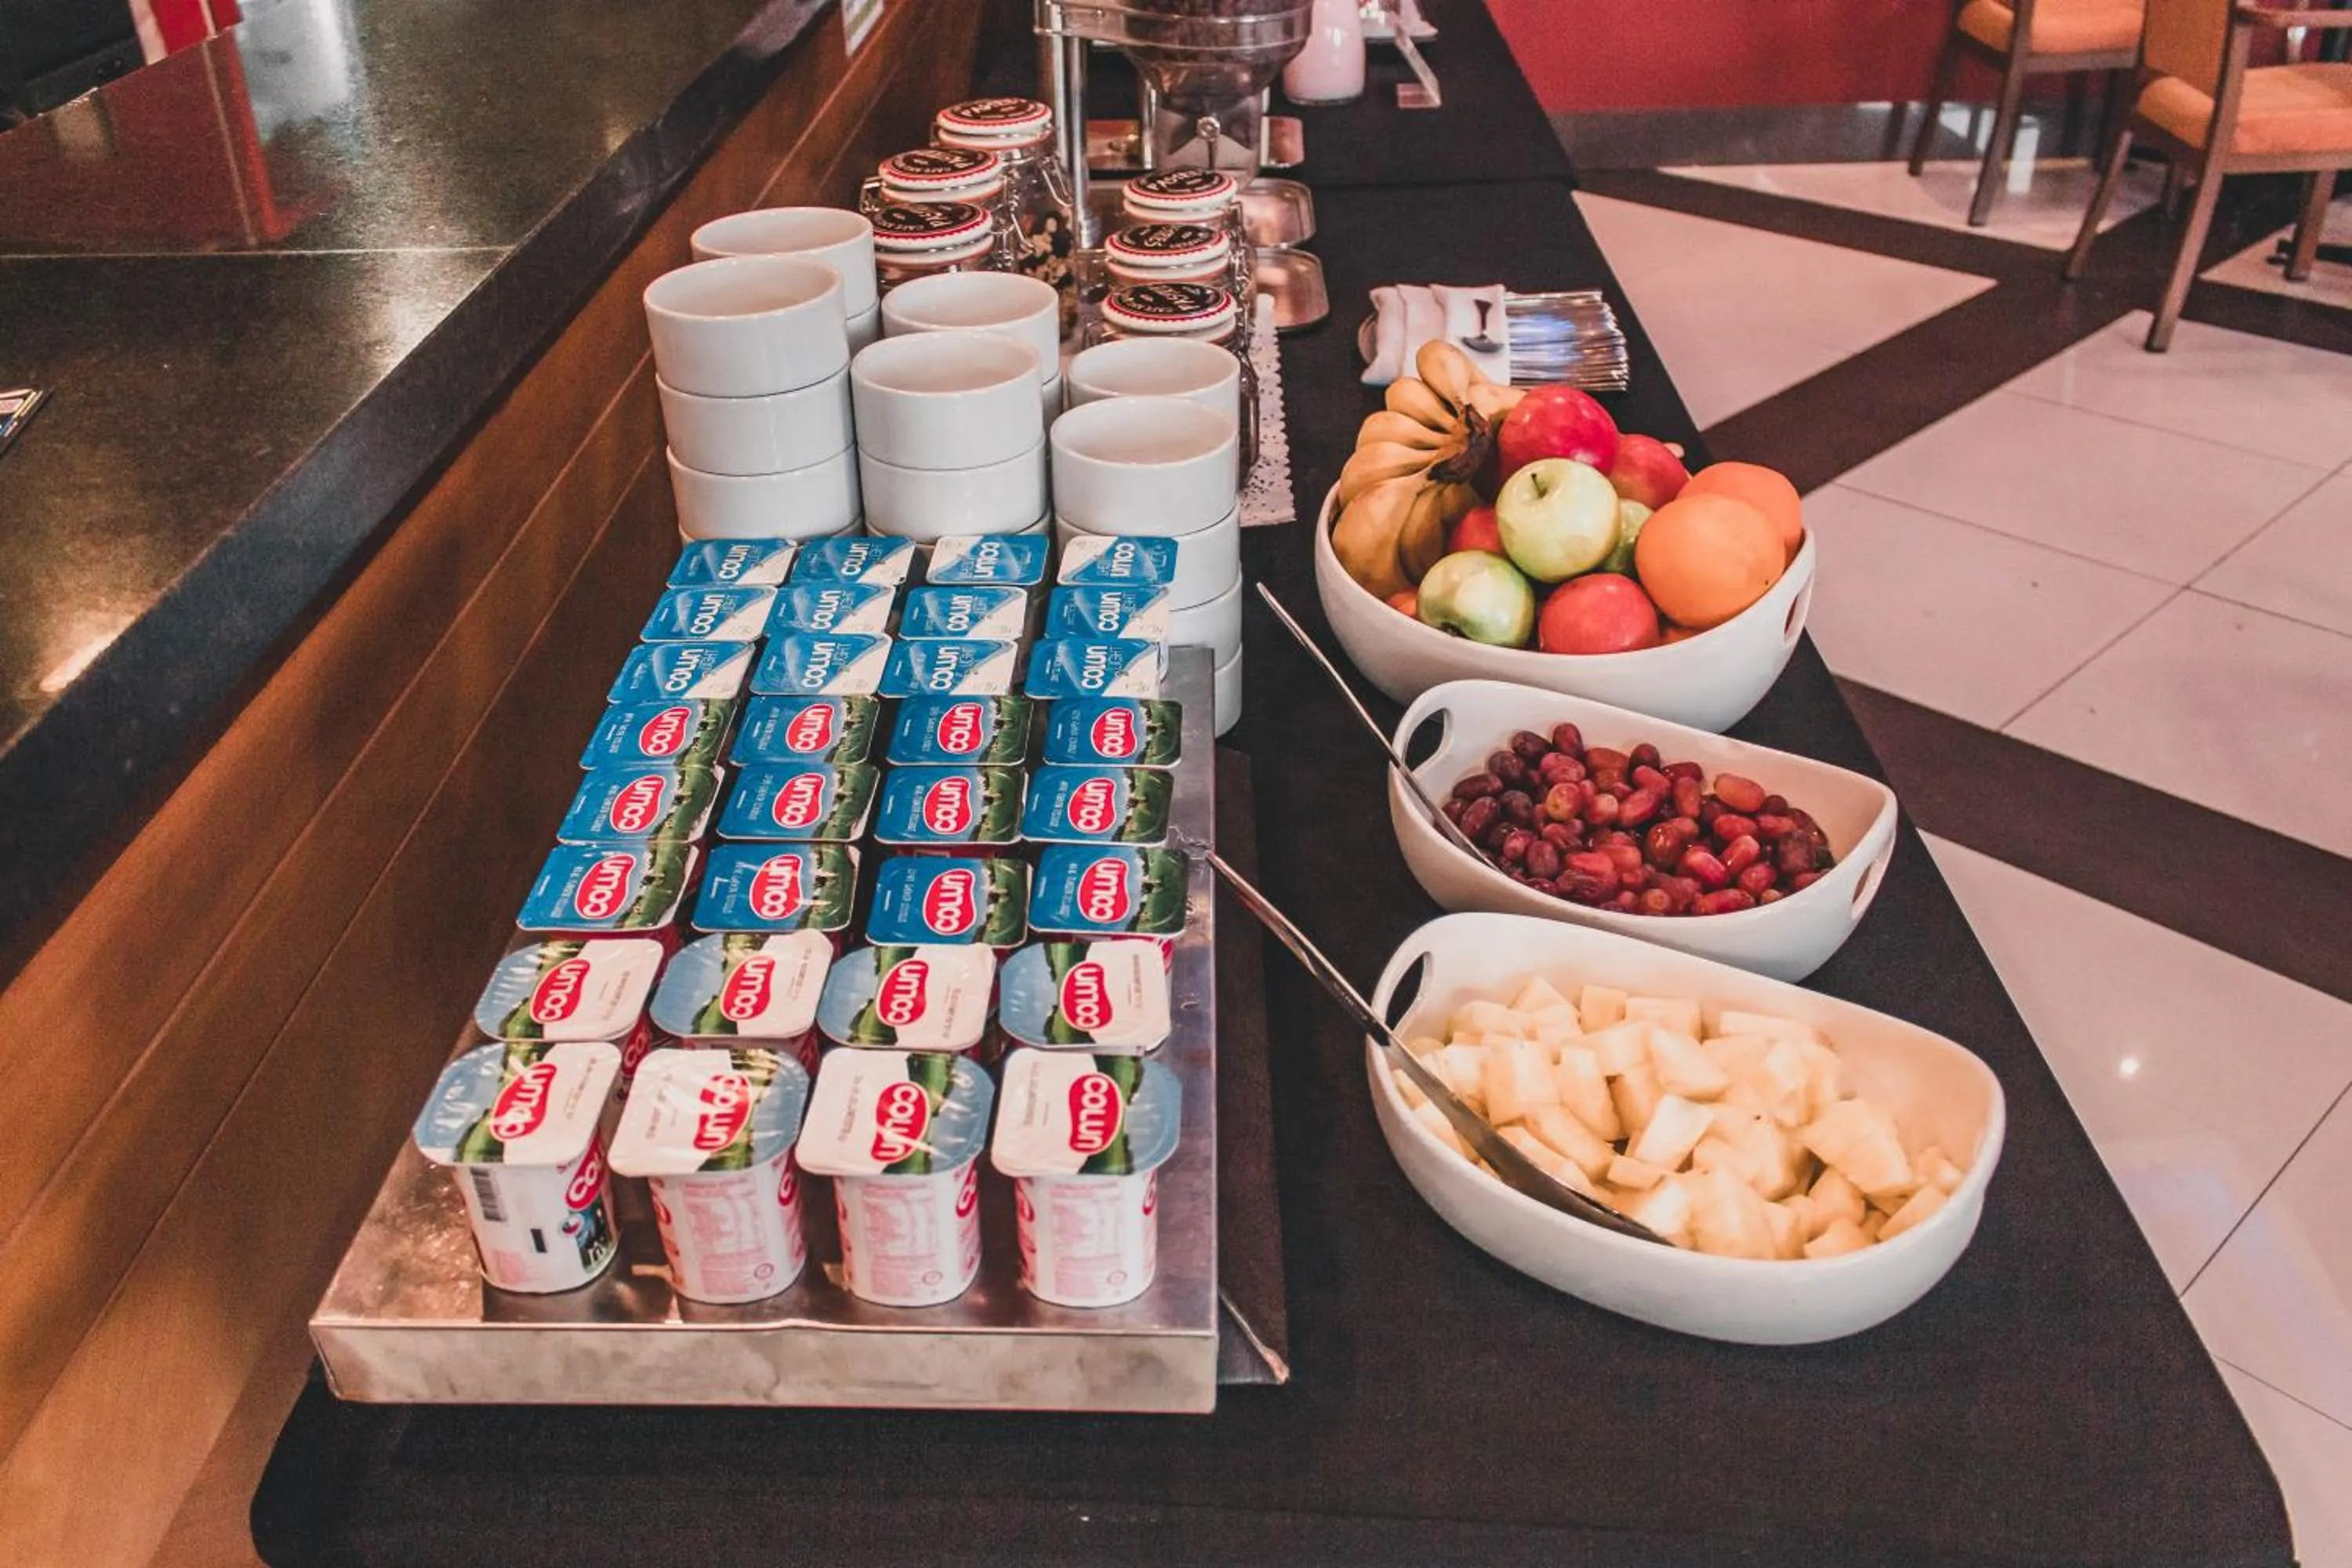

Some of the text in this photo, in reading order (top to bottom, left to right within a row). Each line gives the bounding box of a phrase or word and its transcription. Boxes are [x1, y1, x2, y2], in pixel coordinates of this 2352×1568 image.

[718, 544, 750, 579] COLUN
[840, 543, 869, 575] COLUN
[973, 542, 1000, 577] COLUN
[1110, 543, 1134, 577] COLUN
[690, 594, 726, 633] COLUN
[812, 590, 840, 629] COLUN
[947, 595, 974, 631] COLUN
[1098, 592, 1121, 630] COLUN
[664, 648, 704, 692] COLUN
[802, 642, 836, 688] COLUN
[929, 646, 958, 690] COLUN
[1081, 645, 1108, 689] COLUN
[648, 709, 684, 756] COLUN
[796, 706, 829, 751] COLUN
[950, 706, 978, 750] COLUN
[1103, 710, 1129, 756] COLUN
[619, 779, 659, 831] COLUN
[782, 775, 820, 826] COLUN
[931, 781, 967, 833] COLUN
[1082, 781, 1112, 831] COLUN
[582, 857, 628, 918] COLUN
[761, 858, 797, 918] COLUN
[934, 874, 971, 931] COLUN
[1092, 863, 1123, 921] COLUN
[539, 963, 585, 1021] COLUN
[733, 959, 769, 1019] COLUN
[891, 964, 924, 1024] COLUN
[1073, 966, 1102, 1029] COLUN
[499, 1064, 553, 1137] COLUN
[875, 1085, 918, 1160] COLUN
[1076, 1078, 1110, 1150] COLUN
